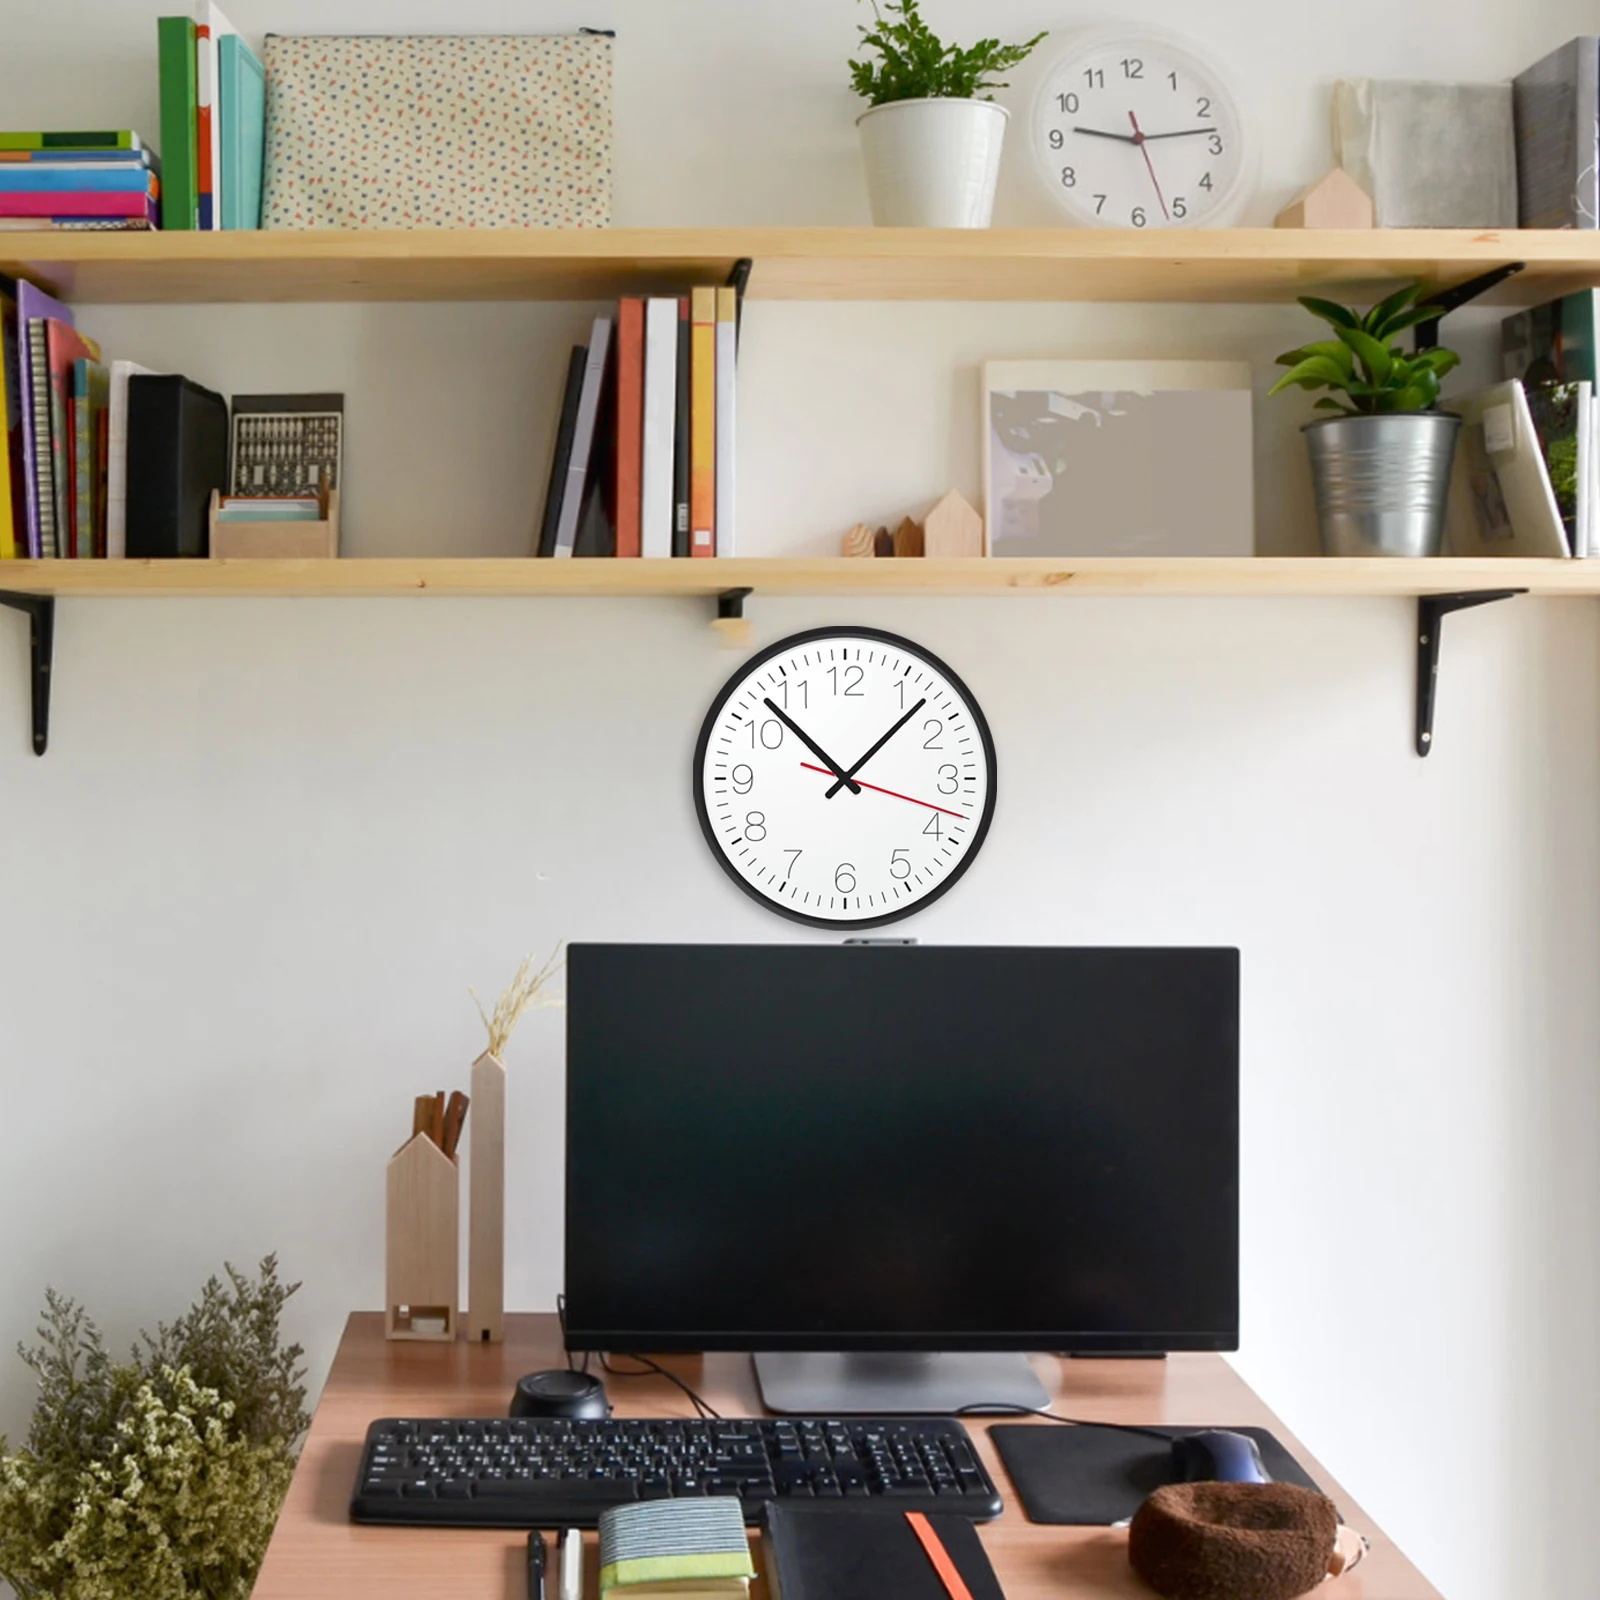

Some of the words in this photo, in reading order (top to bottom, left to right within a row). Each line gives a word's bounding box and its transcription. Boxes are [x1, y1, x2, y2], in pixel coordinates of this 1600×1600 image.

[1083, 68, 1104, 88] 11
[1120, 58, 1144, 78] 12
[1167, 72, 1177, 91] 1
[1056, 92, 1079, 113] 10
[1196, 97, 1211, 117] 2
[1049, 129, 1064, 149] 9
[1208, 134, 1223, 155] 3
[1061, 167, 1076, 187] 8
[1198, 172, 1213, 192] 4
[1093, 194, 1107, 214] 7
[1172, 197, 1187, 218] 5
[1131, 207, 1146, 227] 6
[826, 665, 865, 696] 12
[777, 680, 808, 709] 11
[893, 680, 904, 709] 1
[744, 719, 784, 750] 10
[922, 719, 944, 750] 2
[731, 764, 754, 795] 9
[936, 764, 959, 795] 3
[744, 811, 767, 842] 8
[921, 812, 944, 841] 4
[783, 849, 803, 879] 7
[889, 849, 911, 879] 5
[834, 863, 856, 893] 6
